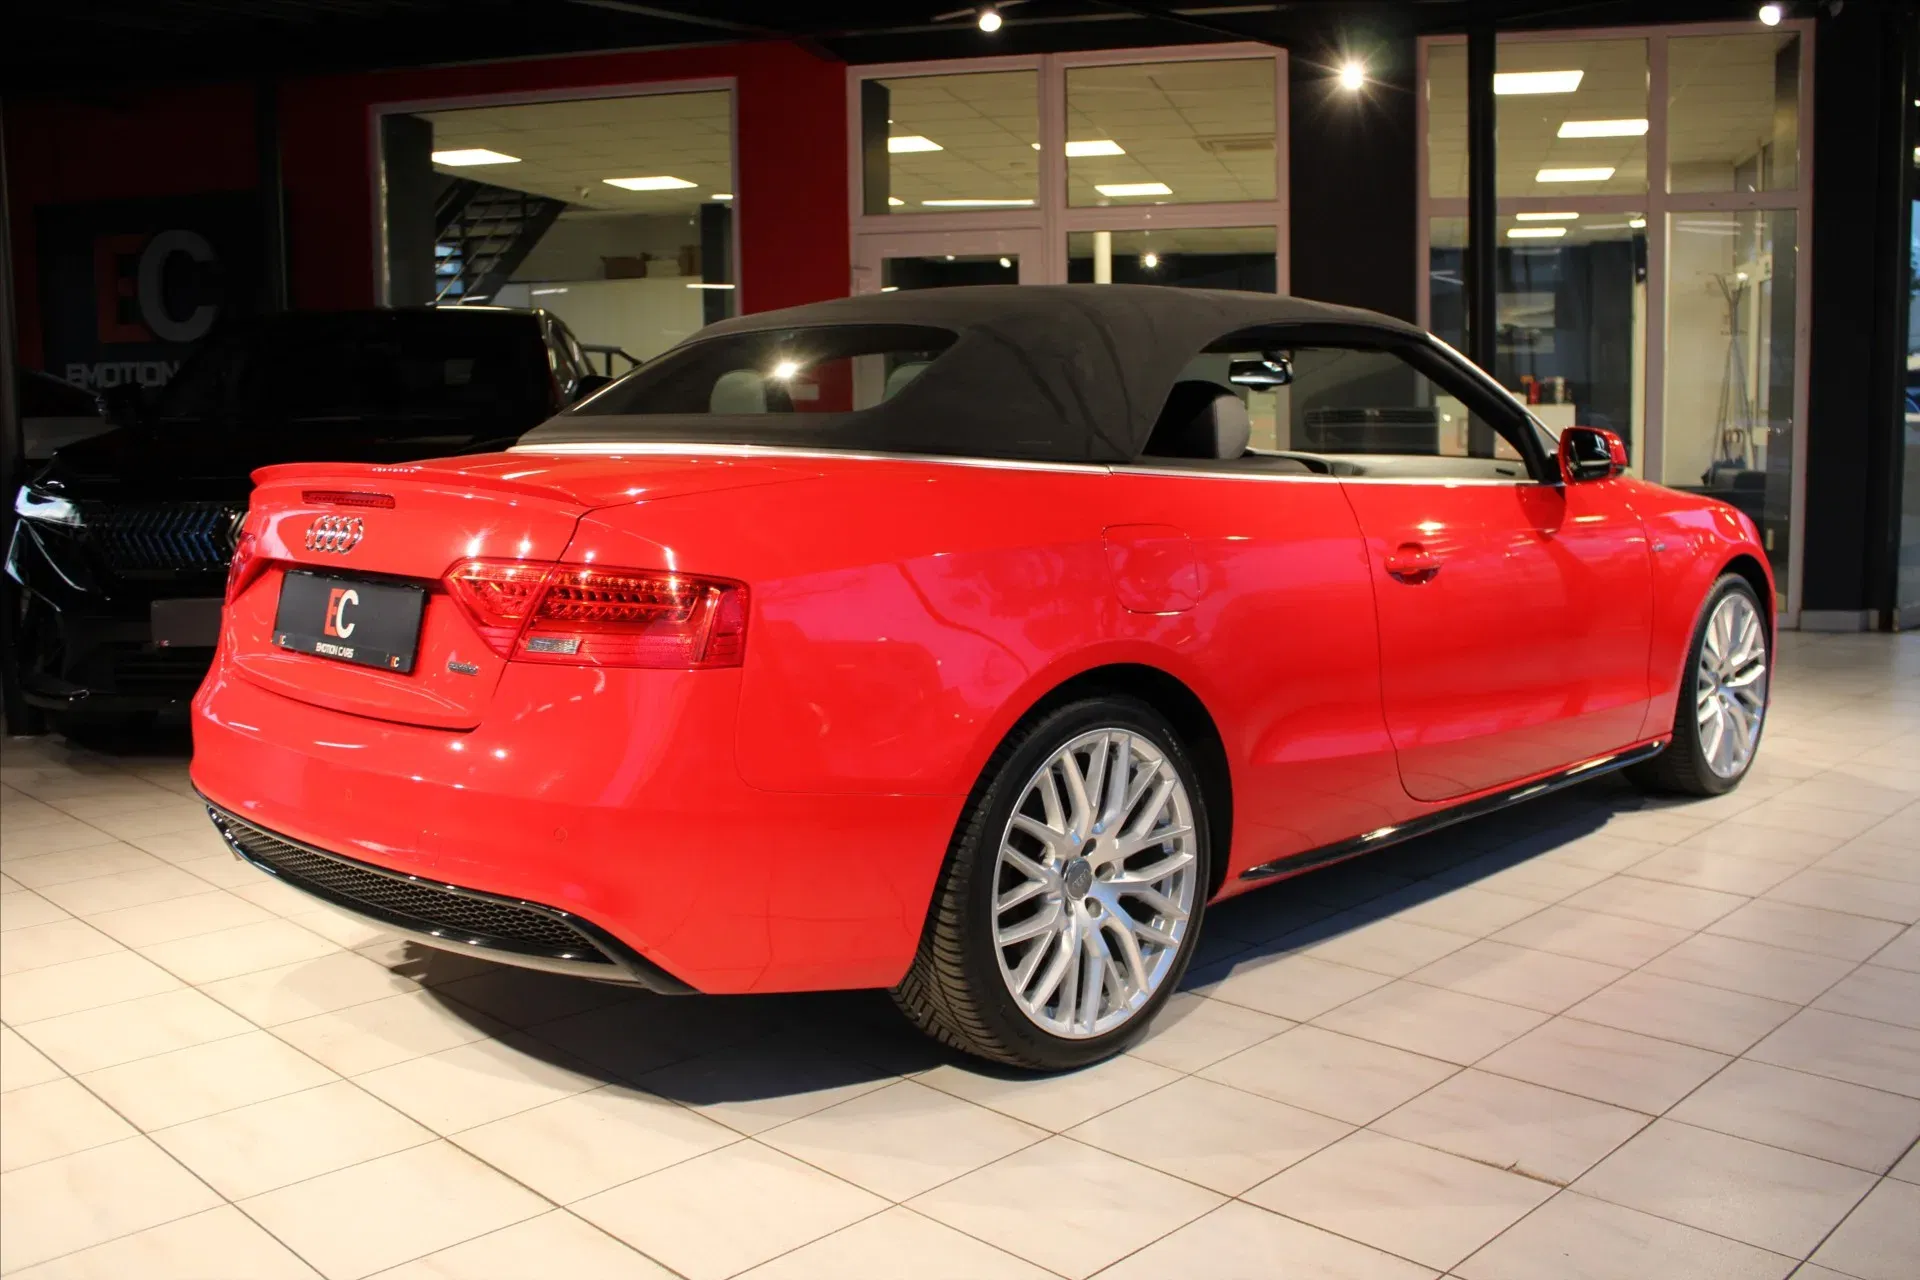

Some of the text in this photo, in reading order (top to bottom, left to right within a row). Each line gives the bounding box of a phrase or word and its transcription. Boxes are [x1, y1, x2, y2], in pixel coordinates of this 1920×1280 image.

[93, 229, 219, 344] EC
[65, 360, 181, 388] EMOTION
[324, 588, 359, 639] EC
[338, 646, 354, 659] CARS
